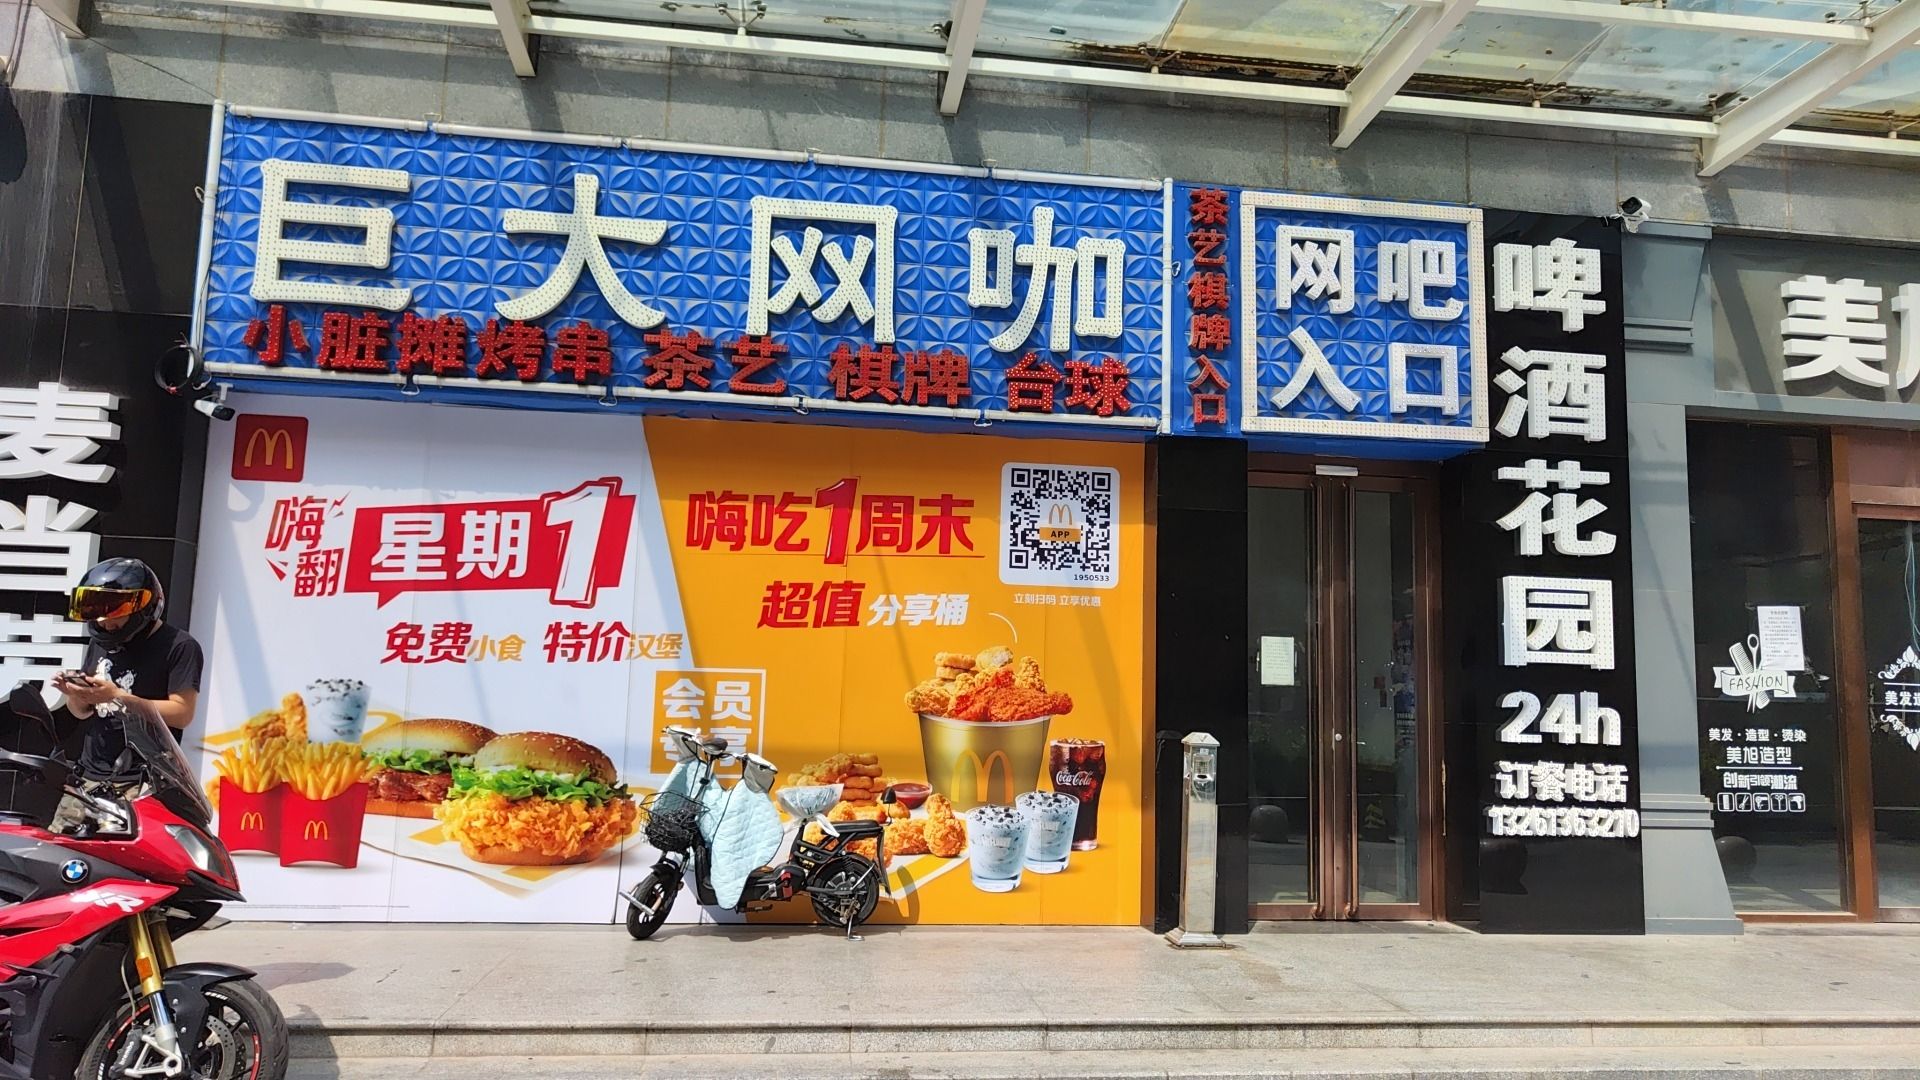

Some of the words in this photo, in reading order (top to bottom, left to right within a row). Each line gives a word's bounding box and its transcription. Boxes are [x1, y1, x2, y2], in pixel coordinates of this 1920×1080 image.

[250, 157, 1126, 352] 巨大网咖
[1276, 224, 1464, 321] 网吧
[1187, 188, 1231, 425] 茶艺棋牌入口
[1781, 275, 1920, 389] 美
[243, 304, 612, 382] 小脏摊烤串
[643, 328, 788, 395] 茶艺
[827, 341, 972, 405] 棋牌
[1005, 352, 1132, 417] 台球
[1272, 326, 1460, 416] 入口
[1492, 237, 1617, 670] 啤酒花园
[686, 476, 976, 566] 嗨吃1周末
[1050, 530, 1070, 539] APP
[1073, 574, 1110, 582] 1950533
[1014, 593, 1056, 605] 立刻扫码
[1059, 595, 1101, 607] 立享优惠
[380, 622, 526, 664] 免费小食
[543, 622, 683, 663] 特价汉堡
[662, 678, 752, 721] 会员
[1729, 674, 1784, 690] FASHION
[1500, 690, 1622, 746] 24h
[1726, 746, 1792, 765] 美旭造型
[1496, 760, 1629, 802] 订餐电话
[1723, 771, 1798, 790] 创新引领潮流
[1488, 805, 1640, 838] 13261363210
